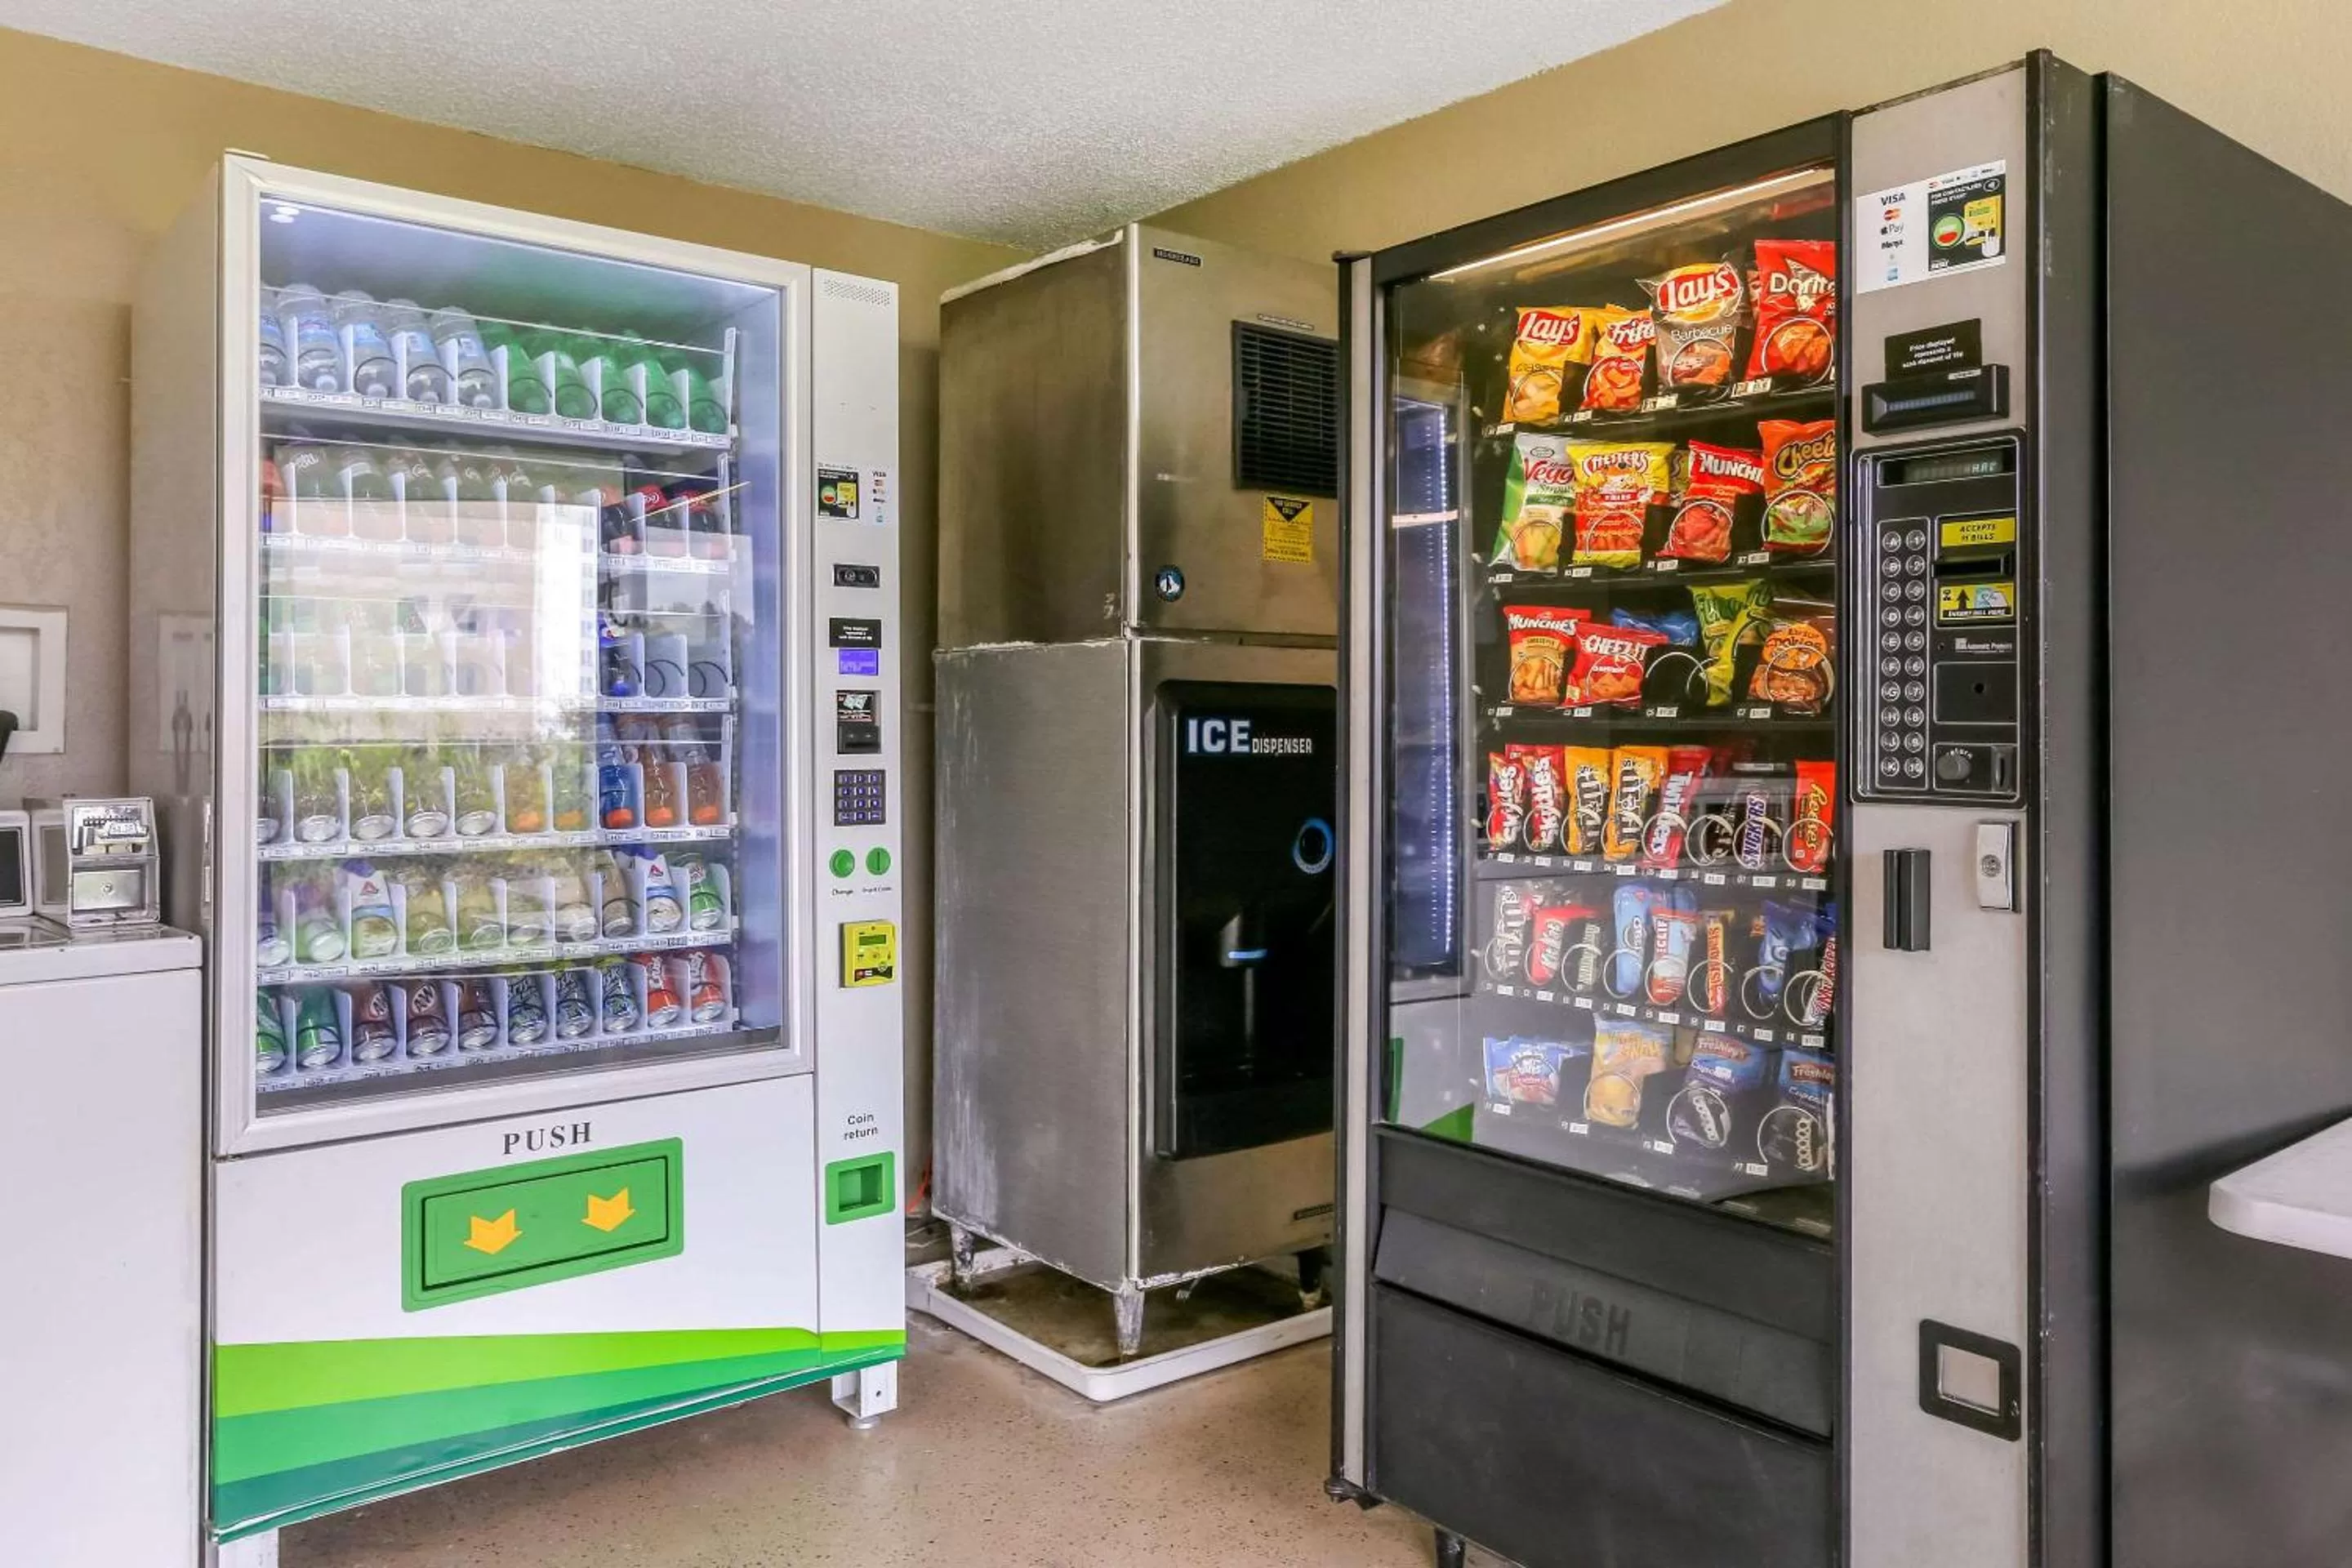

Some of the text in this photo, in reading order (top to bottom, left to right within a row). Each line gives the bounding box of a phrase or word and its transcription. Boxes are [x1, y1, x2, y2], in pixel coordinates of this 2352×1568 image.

[1881, 193, 1906, 205] VISA
[1666, 269, 1731, 311] Lay's
[1518, 311, 1579, 345] Lay's
[1671, 323, 1733, 341] Barbecue
[1699, 452, 1764, 483] MUNCHI
[1775, 433, 1835, 476] Cheet
[1524, 457, 1575, 484] Vegg
[1508, 613, 1578, 636] MUNCHIES
[1188, 719, 1312, 753] ICE DISPENSER
[844, 1127, 879, 1141] return
[848, 1113, 874, 1125] Coin
[503, 1122, 591, 1156] PUSH
[1530, 1280, 1632, 1356] PUSH
